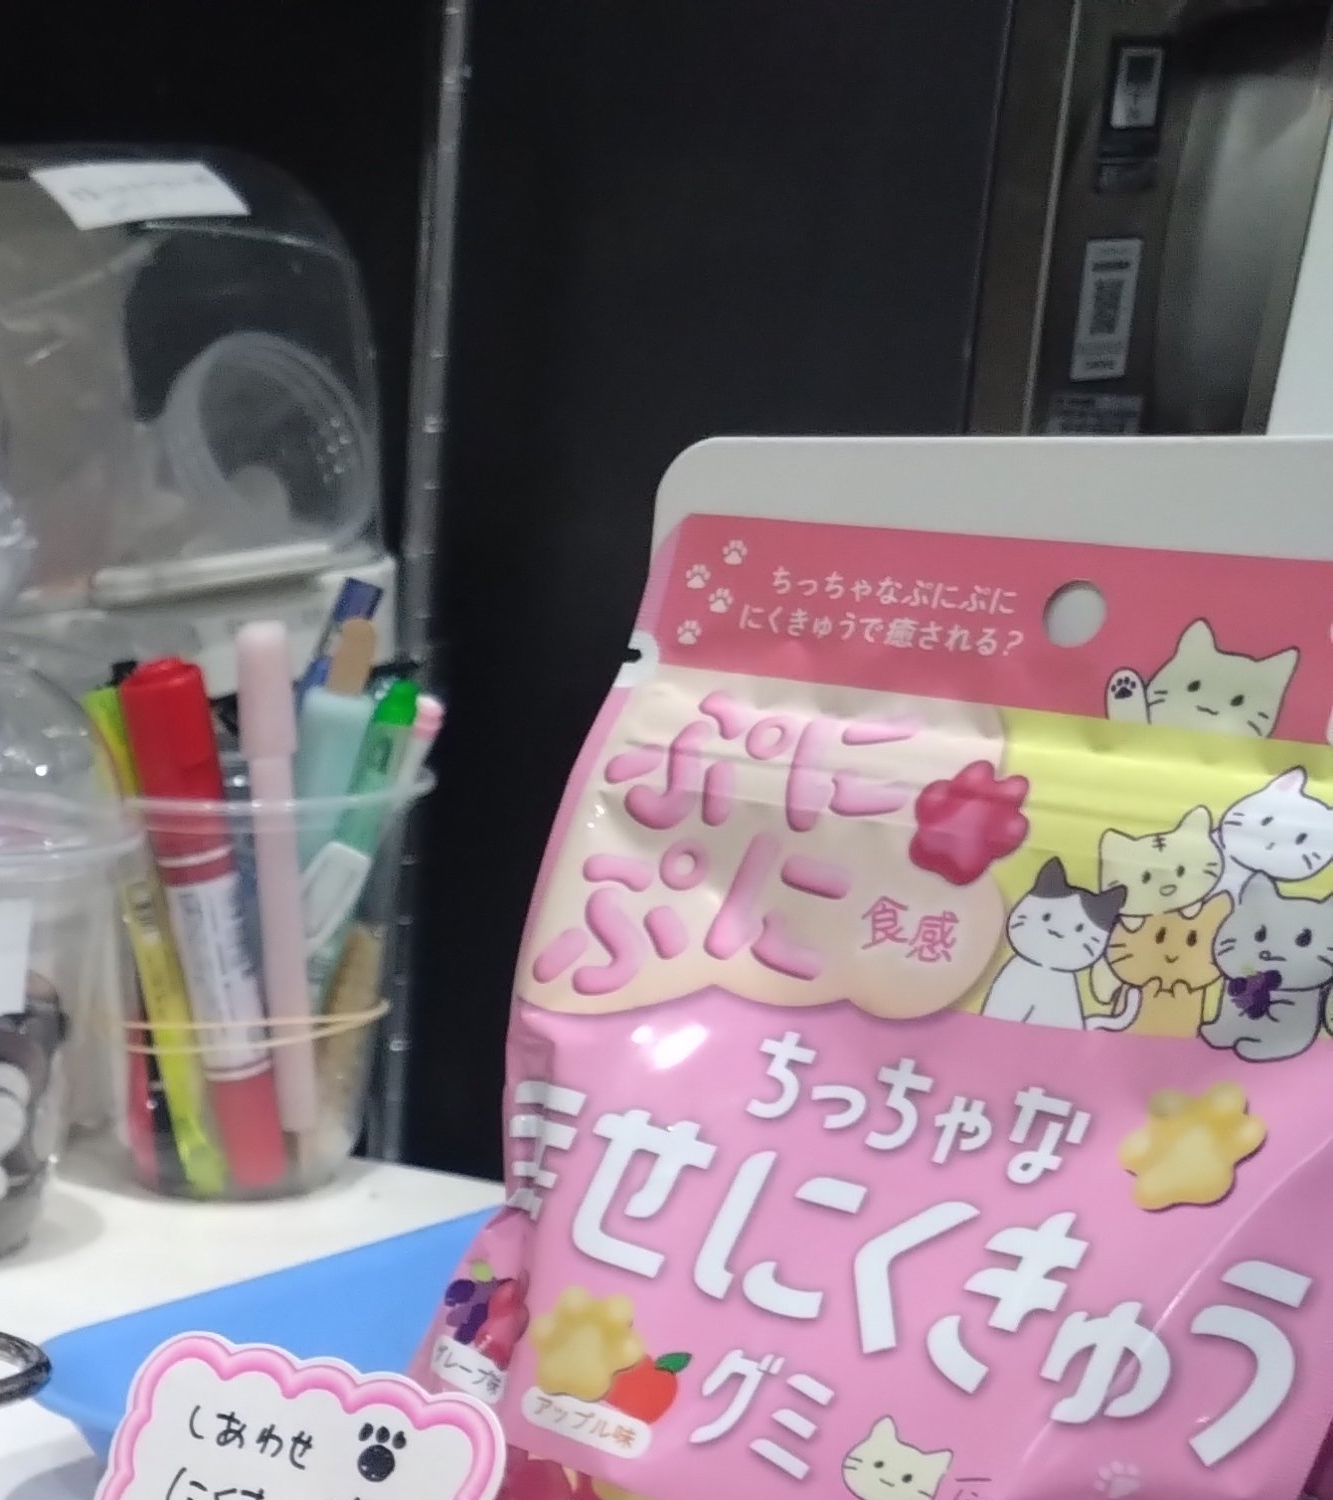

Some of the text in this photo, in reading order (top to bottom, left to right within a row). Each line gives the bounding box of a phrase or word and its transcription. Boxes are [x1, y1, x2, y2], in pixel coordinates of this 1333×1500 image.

[770, 565, 1020, 615] ちっちゃなぷにぷに
[605, 689, 918, 831] ぷに
[533, 829, 961, 998] ぷに 食感
[745, 1030, 1093, 1186] ちっちゃな
[188, 1403, 315, 1471] しあわせ
[532, 1394, 638, 1450] アップル味
[689, 1344, 837, 1484] グミ
